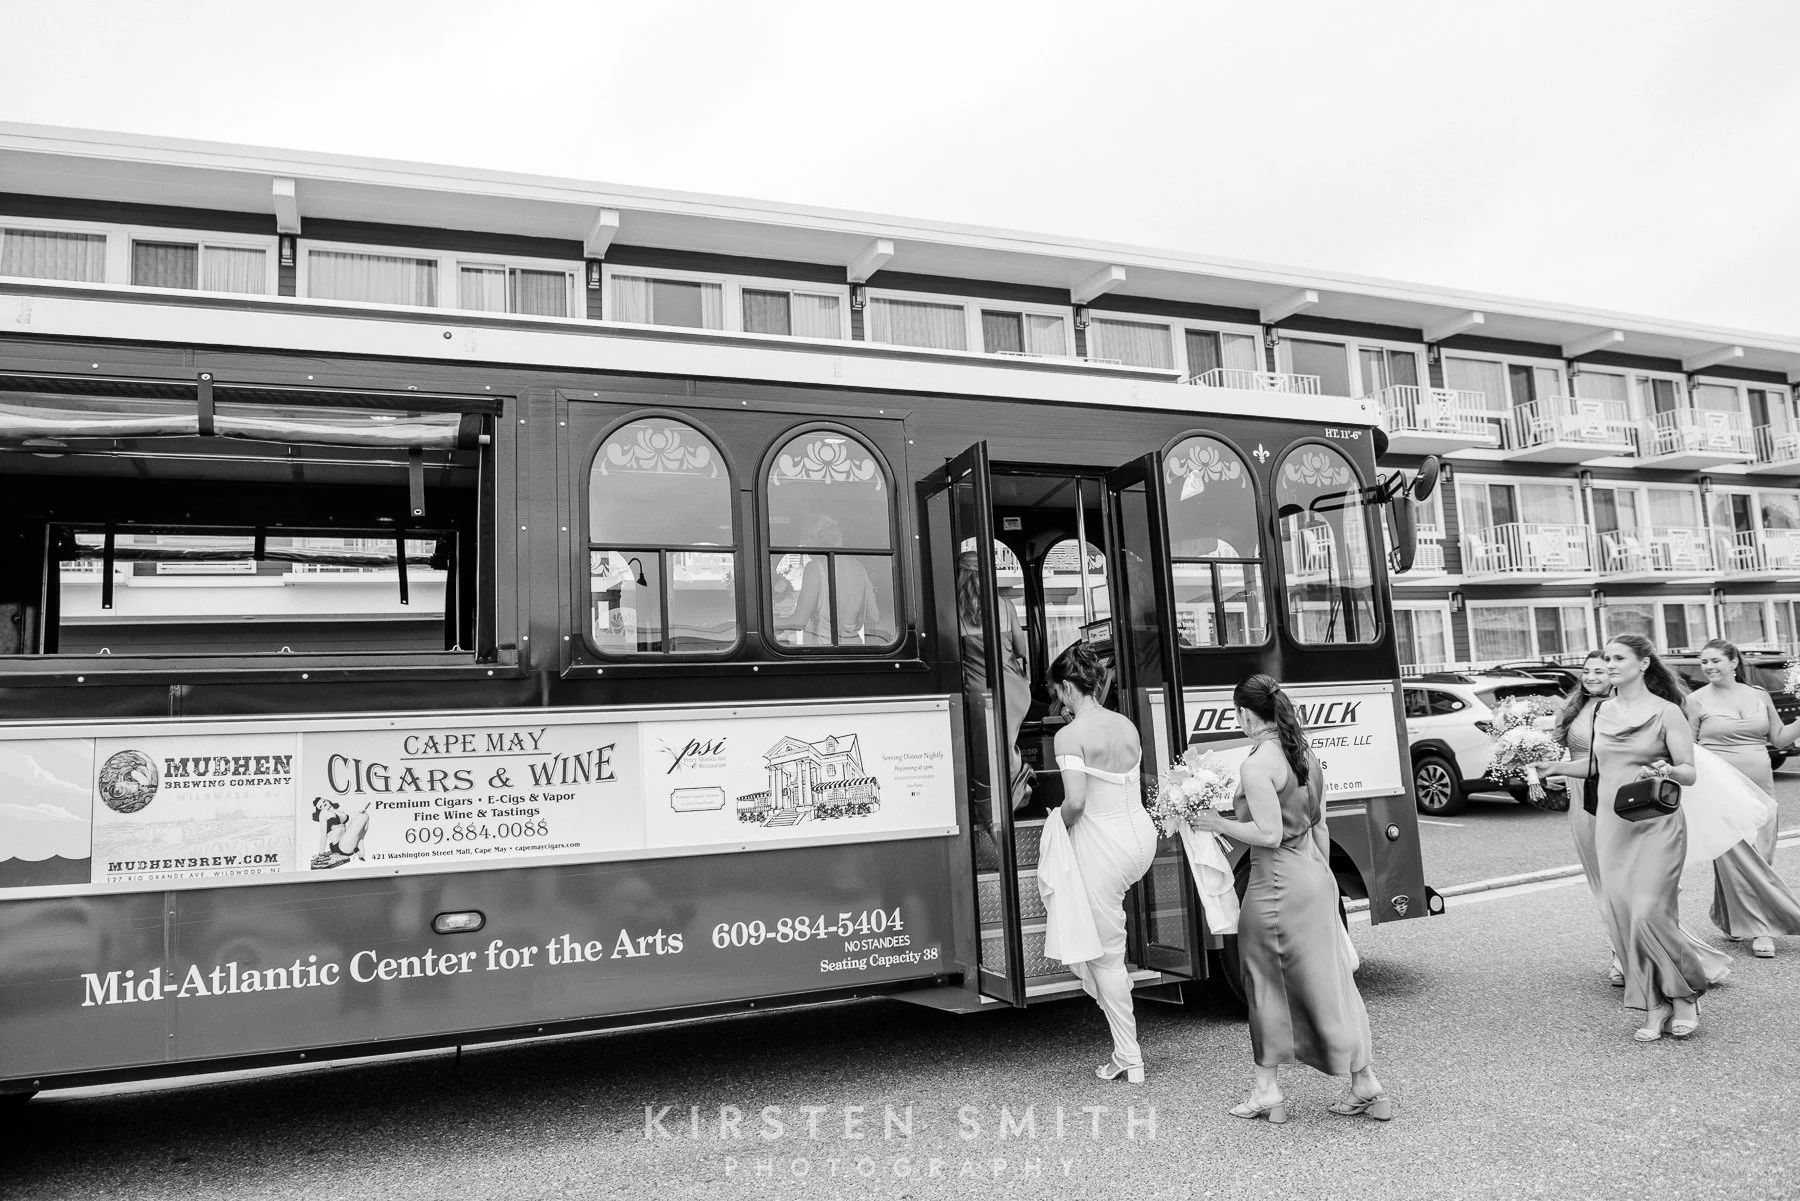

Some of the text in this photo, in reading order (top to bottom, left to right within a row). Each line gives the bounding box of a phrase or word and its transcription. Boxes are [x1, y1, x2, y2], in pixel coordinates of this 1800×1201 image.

[1324, 427, 1340, 438] HT.
[403, 727, 548, 755] CAPE MAY
[1353, 734, 1373, 746] LLC
[667, 737, 727, 775] psi
[164, 755, 292, 778] MUDHEN
[327, 742, 617, 795] CIGARS & WINE
[164, 777, 292, 789] BREWING COMPANY
[375, 791, 576, 810] Premium Cigars E-Cigs & Vapor
[414, 806, 540, 821] Fine Wine & Tastings
[405, 819, 549, 844] 609.884.0088
[388, 849, 429, 860] Washington
[455, 848, 472, 856] Mall,
[475, 847, 491, 855] Cape
[515, 842, 581, 853] capemaycigars.com
[108, 853, 278, 872] MUDHENBREW.COM
[148, 872, 184, 881] GRANDE
[711, 907, 904, 948] 609-884-5404
[844, 935, 911, 953] NO STANDEES
[80, 928, 684, 1007] Mid-Atlantic Center for the Arts
[820, 947, 939, 975] Seating Capacity 38
